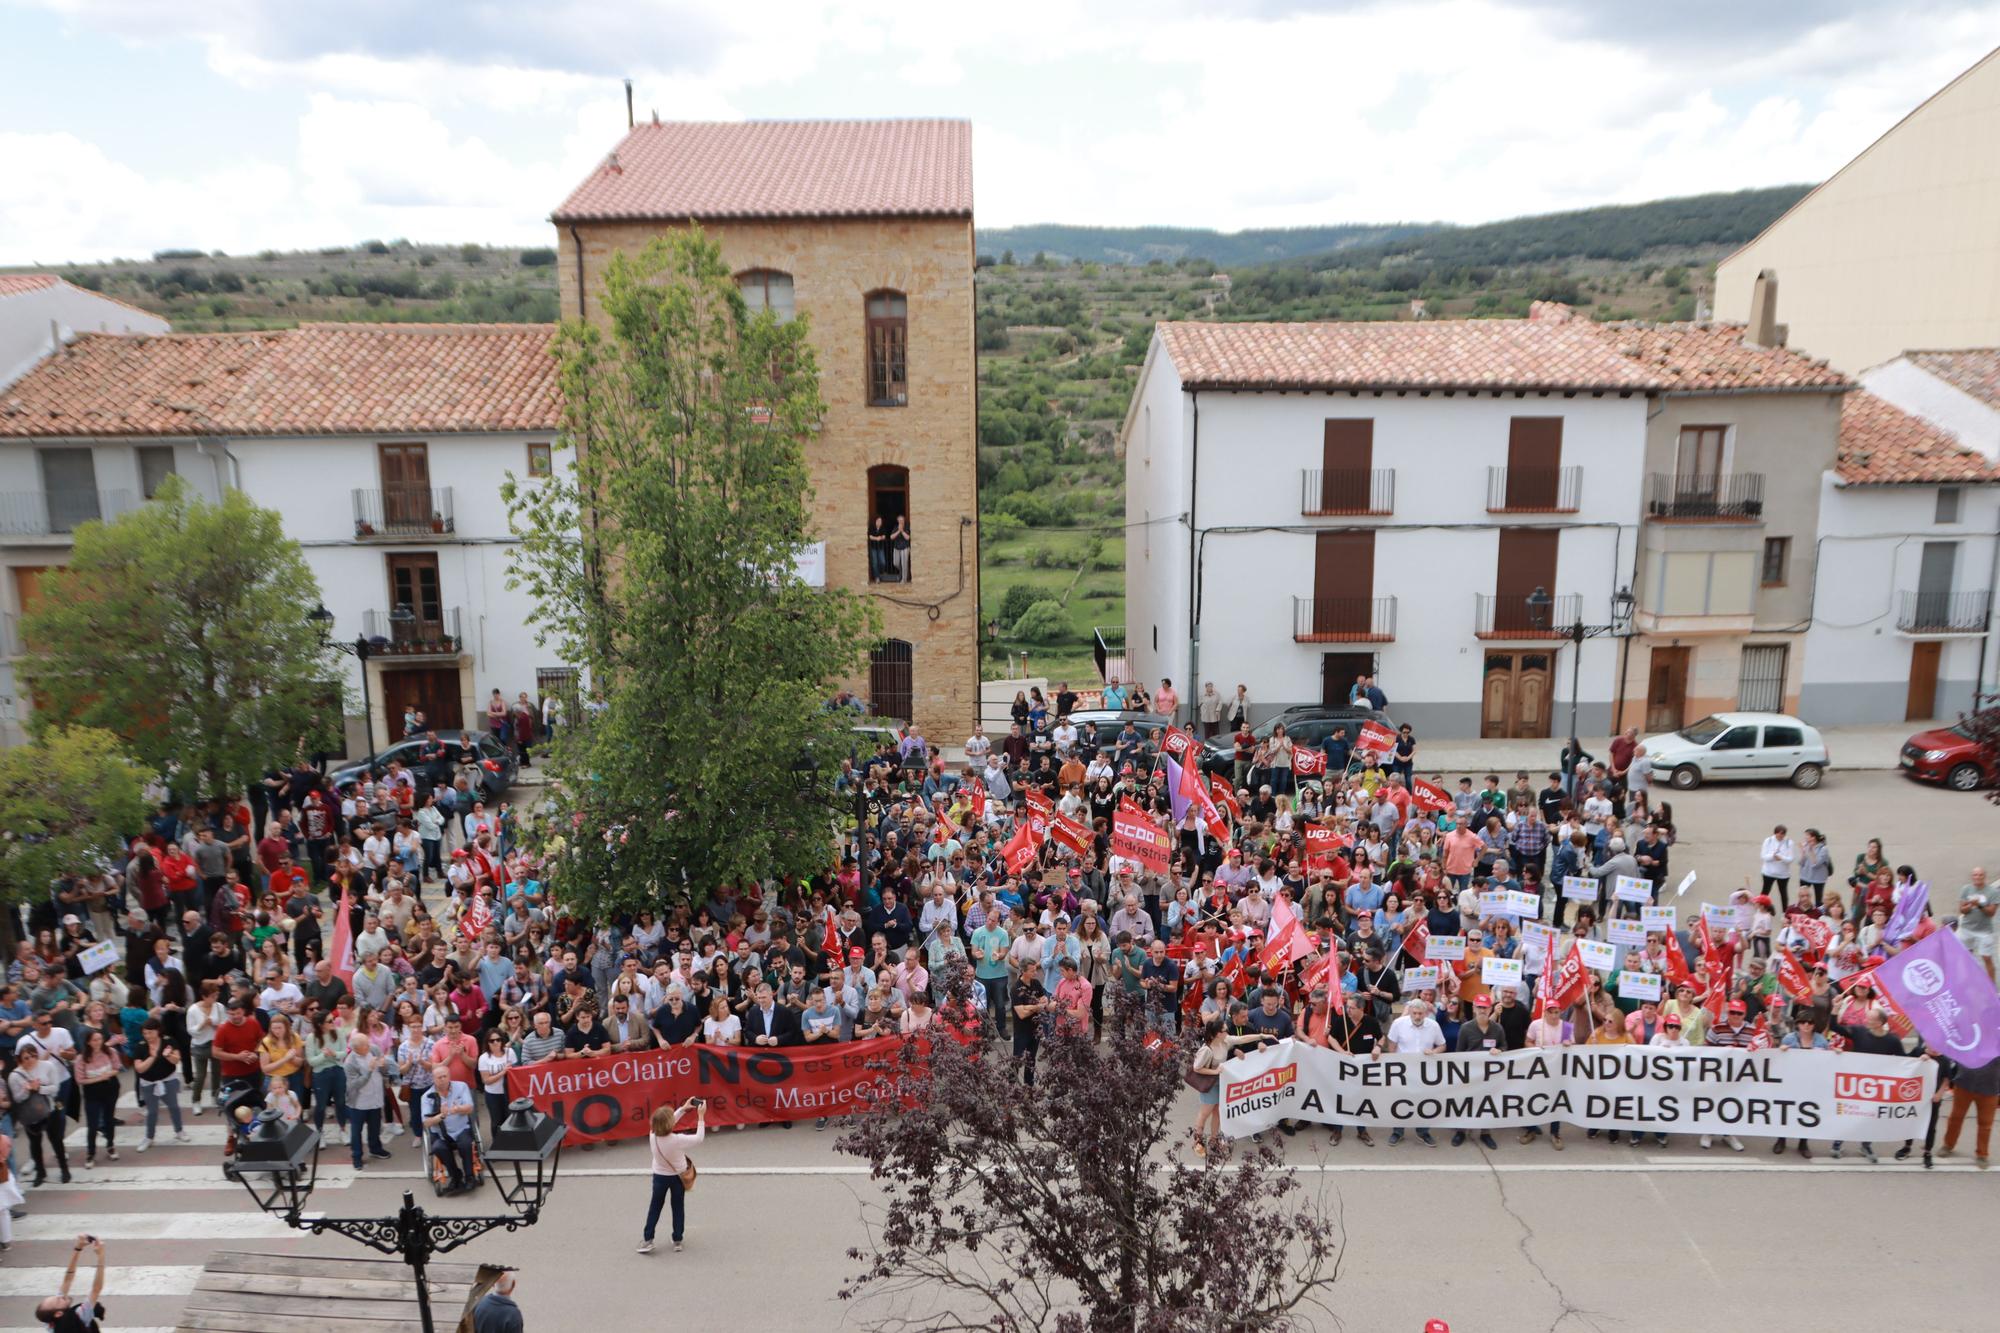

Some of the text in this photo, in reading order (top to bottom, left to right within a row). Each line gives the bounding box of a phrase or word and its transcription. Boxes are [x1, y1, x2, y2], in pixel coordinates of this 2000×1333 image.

[1415, 786, 1437, 801] UGT
[1115, 821, 1155, 844] CCOO
[1307, 829, 1331, 839] UGT
[1914, 962, 1940, 987] UGT
[527, 1055, 691, 1098] MarieClaire
[697, 1050, 794, 1086] NO
[804, 1058, 832, 1073] es
[1339, 1053, 1783, 1086] PER UN PLA INDUSTRIAL
[1229, 1073, 1275, 1098] CCOO
[1837, 1076, 1896, 1100] UGT
[736, 1088, 767, 1109] de
[1301, 1089, 1820, 1127] A LA COMARCA DELS PORTS
[1878, 1105, 1918, 1119] FICA
